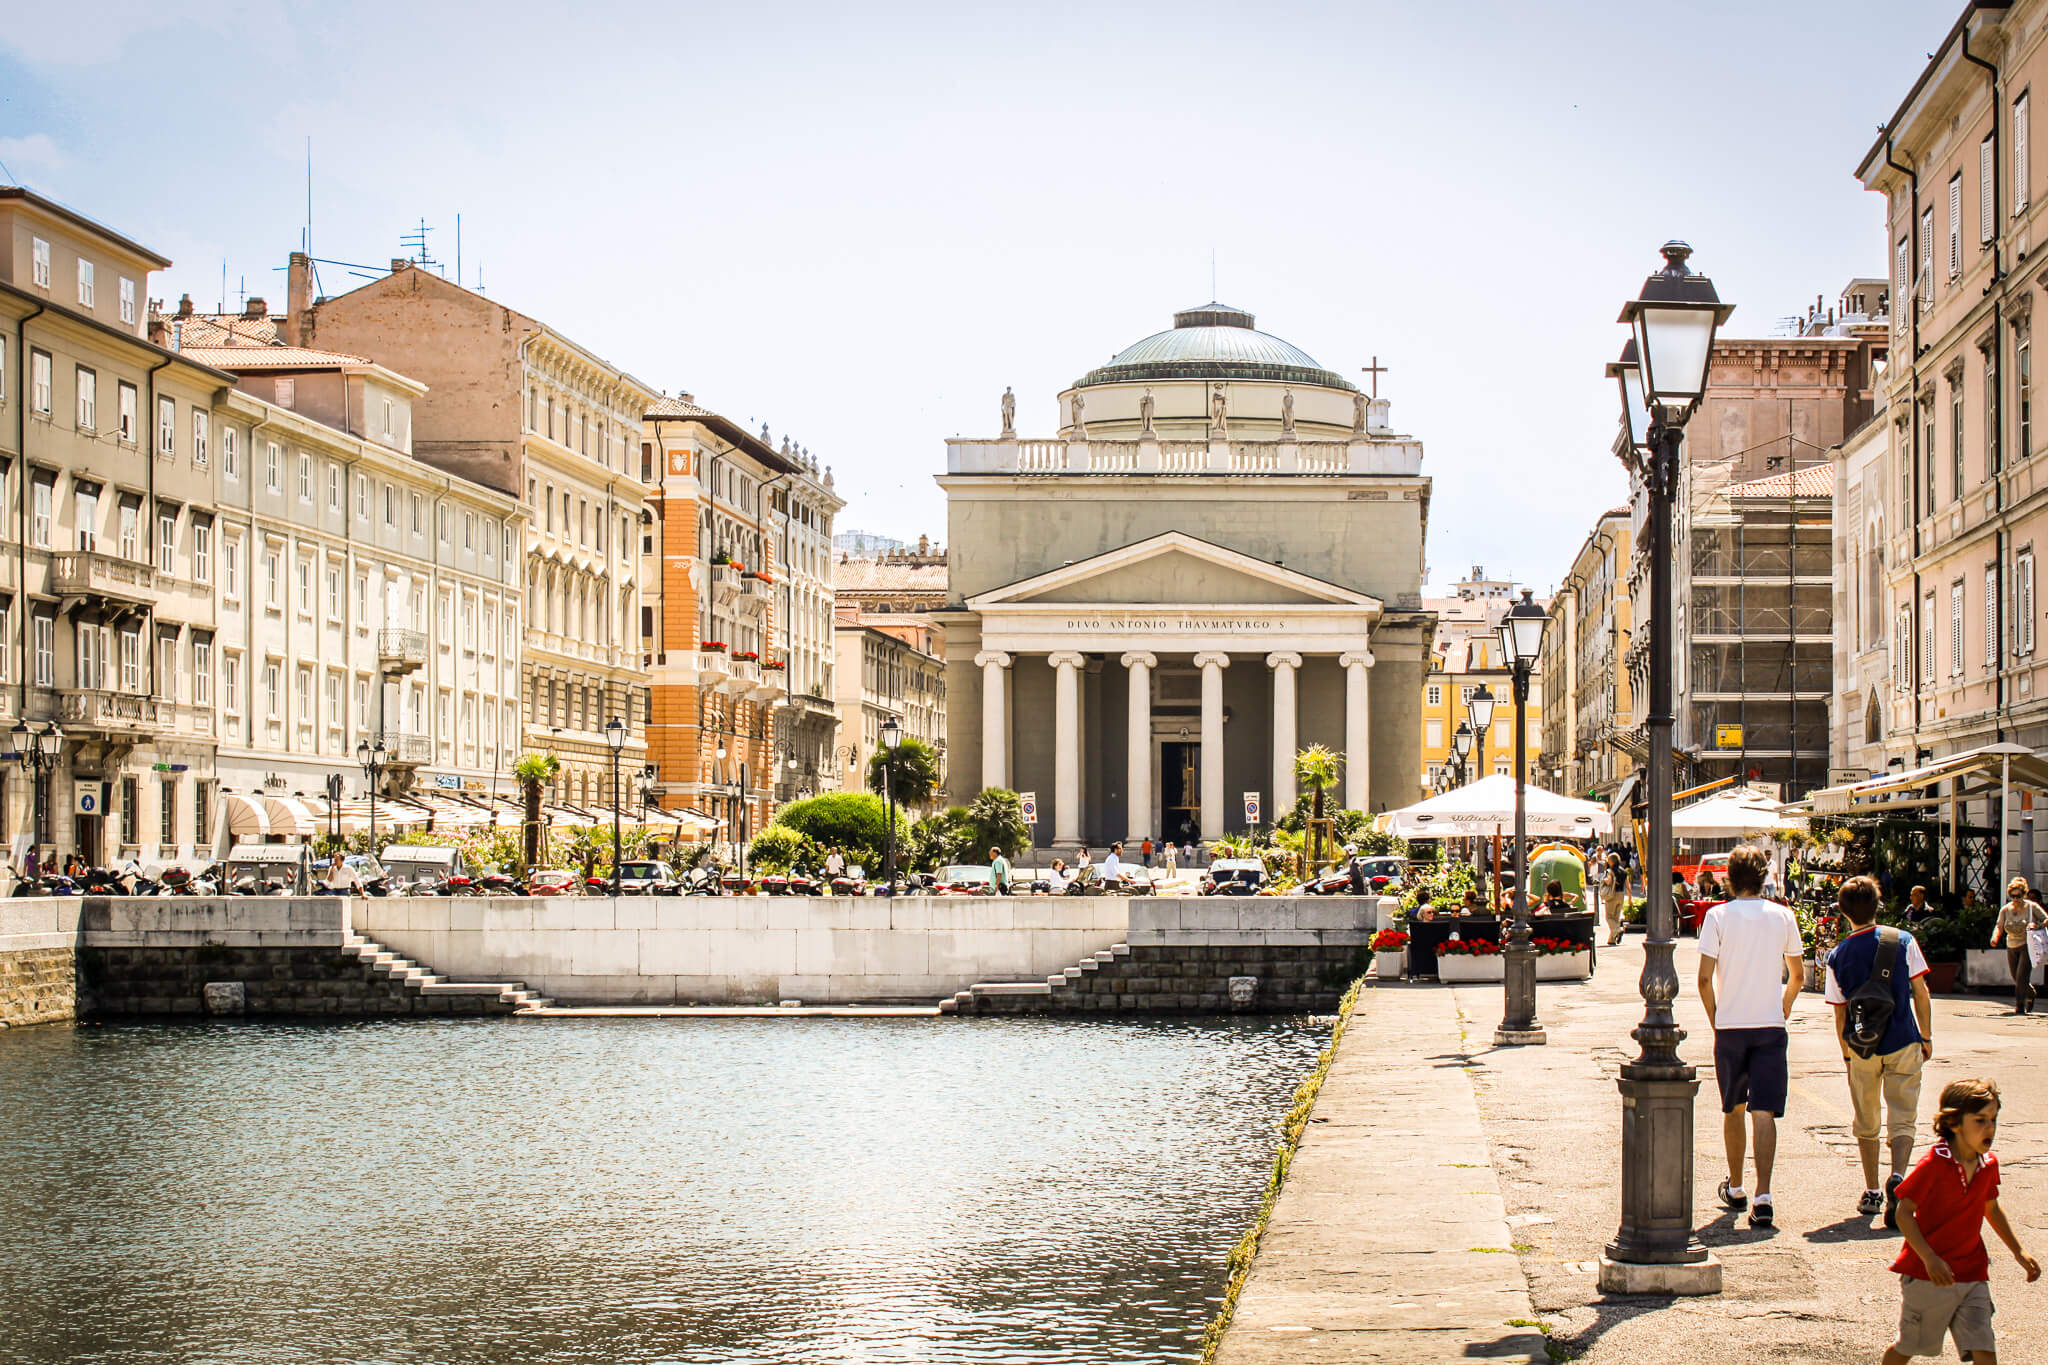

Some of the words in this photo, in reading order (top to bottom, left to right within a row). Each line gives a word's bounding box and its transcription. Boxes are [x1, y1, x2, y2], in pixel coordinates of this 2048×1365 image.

[1067, 620, 1100, 629] DIVO
[1110, 620, 1167, 629] ANTONIO
[1178, 620, 1270, 629] THAVMATVRGO
[1279, 620, 1285, 629] S
